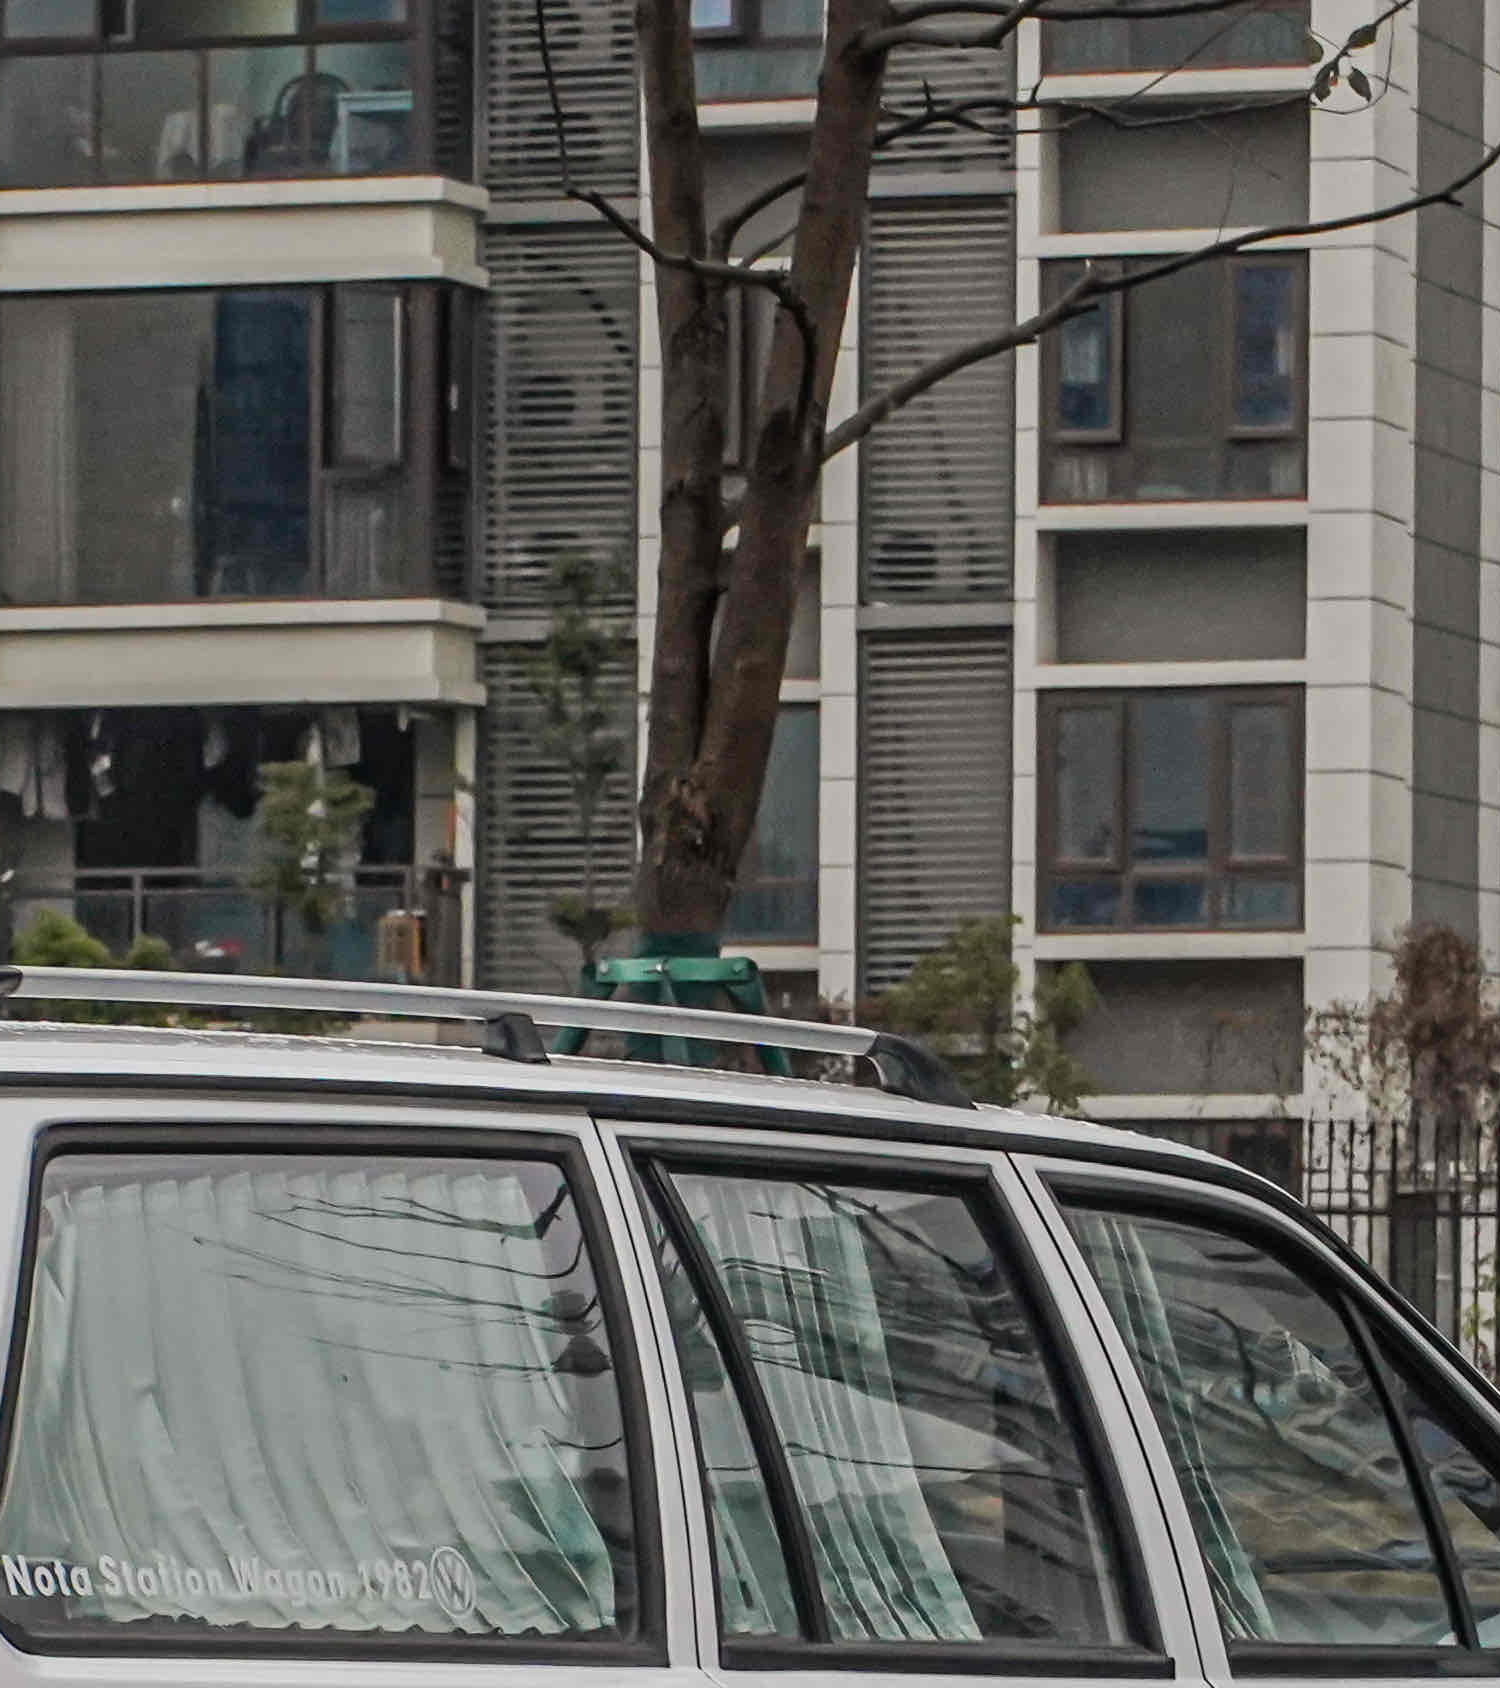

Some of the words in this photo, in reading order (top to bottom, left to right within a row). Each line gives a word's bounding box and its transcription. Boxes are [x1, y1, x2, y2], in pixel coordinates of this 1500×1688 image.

[1, 1553, 96, 1598] Nota
[99, 1552, 224, 1599] Station
[226, 1552, 347, 1607] Wagon
[357, 1558, 434, 1600] 1982
